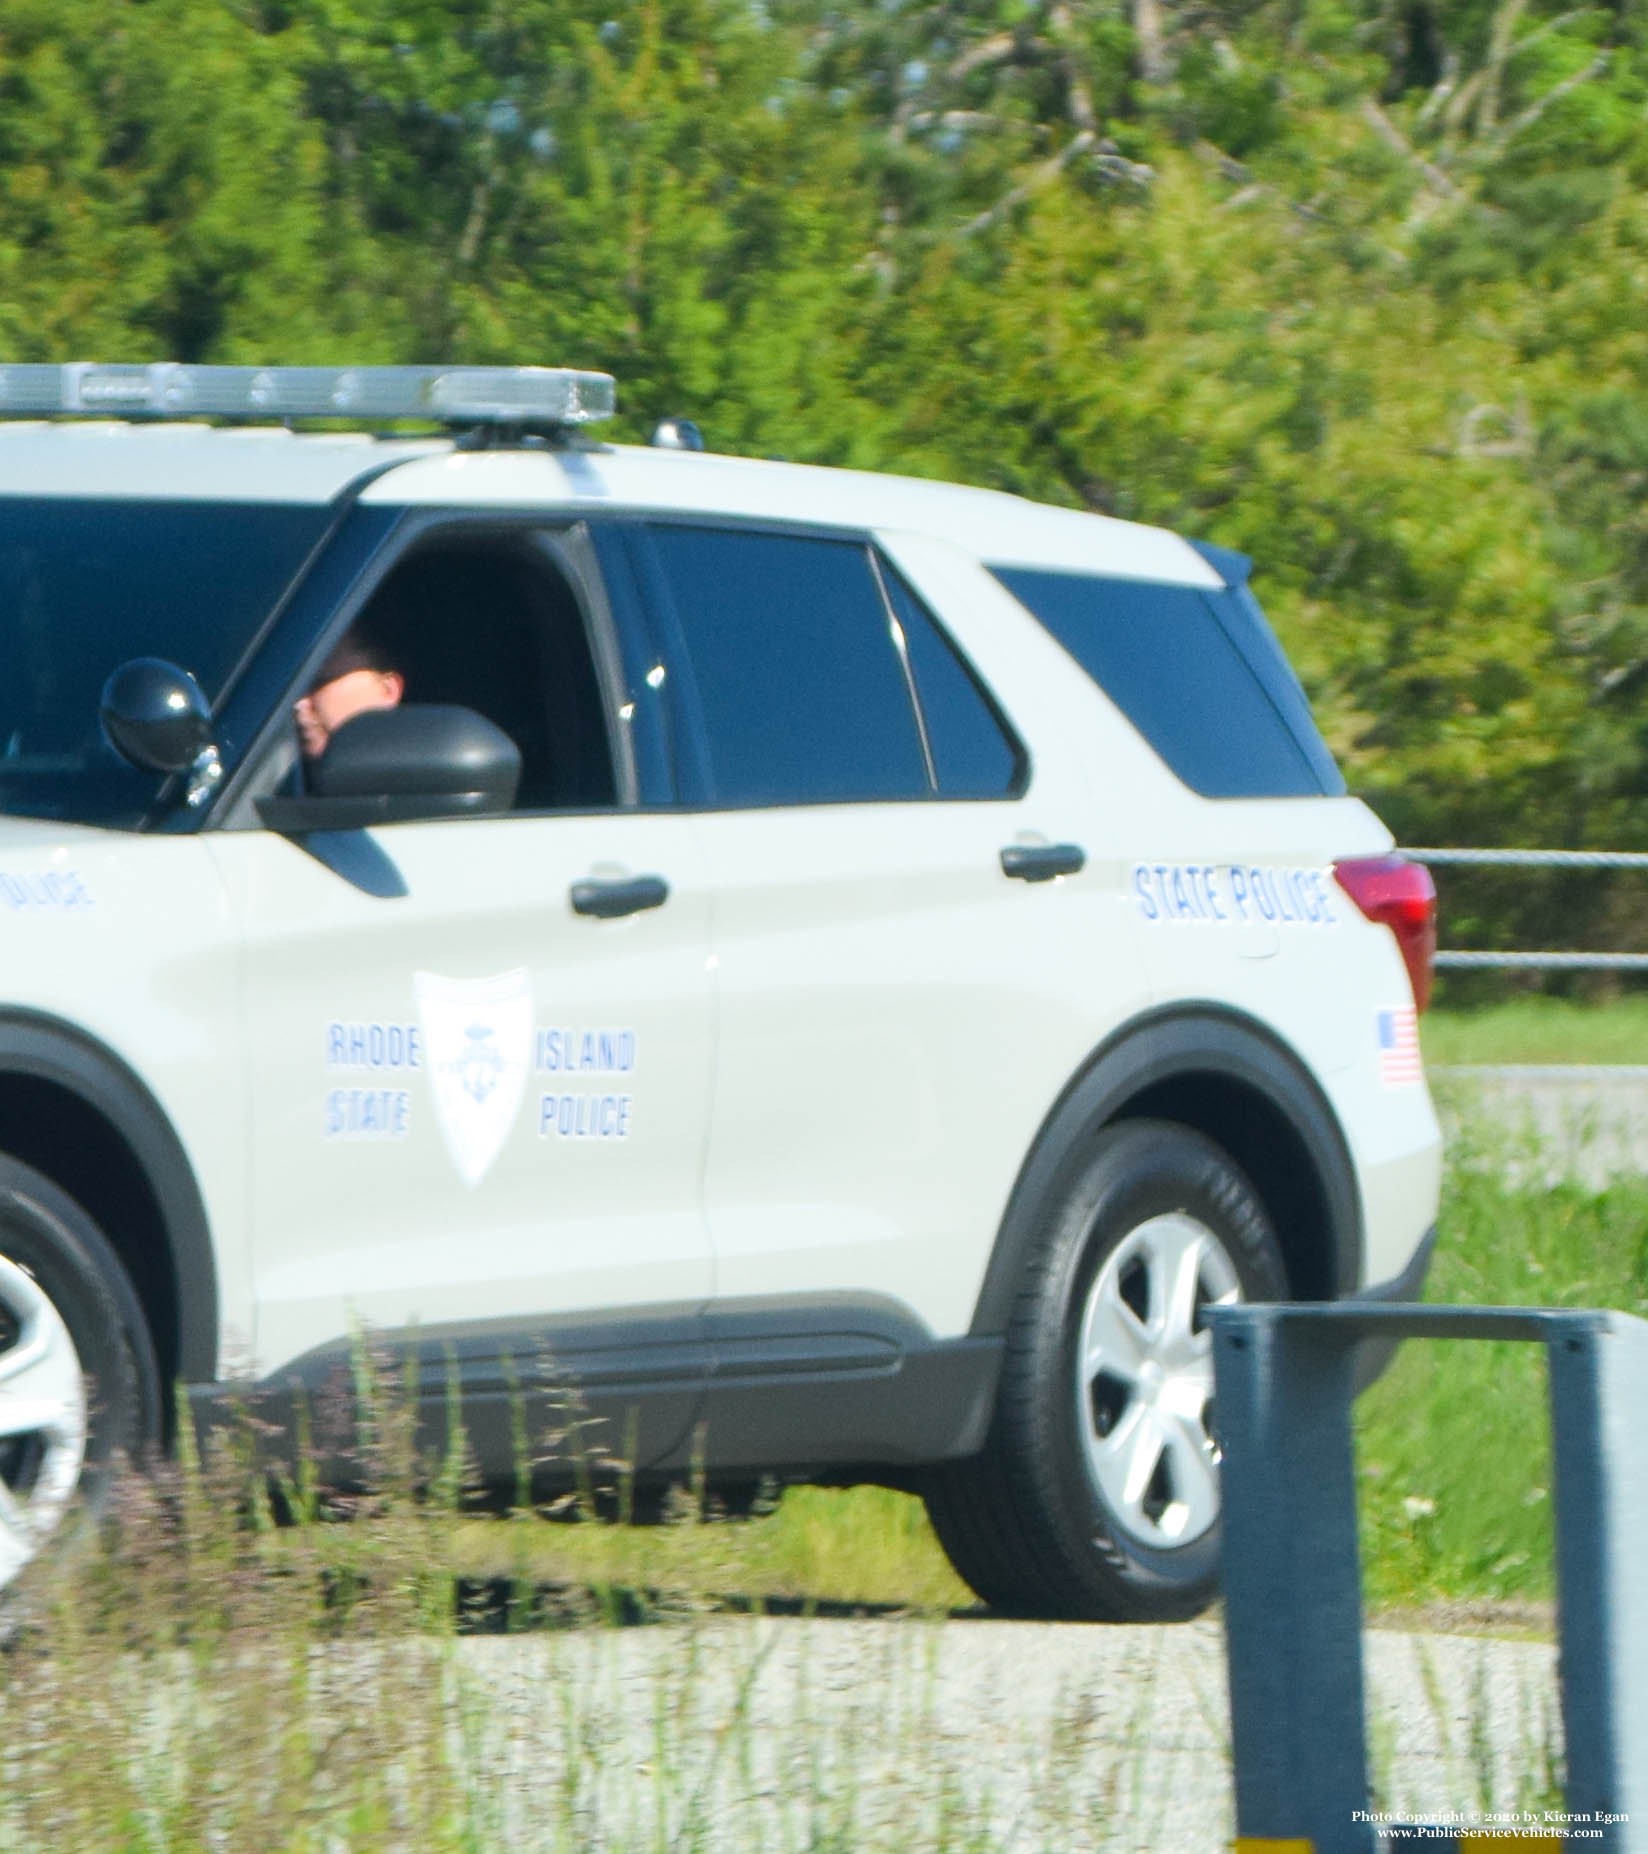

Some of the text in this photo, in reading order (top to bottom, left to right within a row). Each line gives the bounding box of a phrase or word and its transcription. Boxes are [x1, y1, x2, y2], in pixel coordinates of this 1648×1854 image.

[1135, 864, 1337, 922] STATE POLICE
[327, 1022, 636, 1072] RHODE ISLAND
[325, 1088, 633, 1137] STATE POLICE
